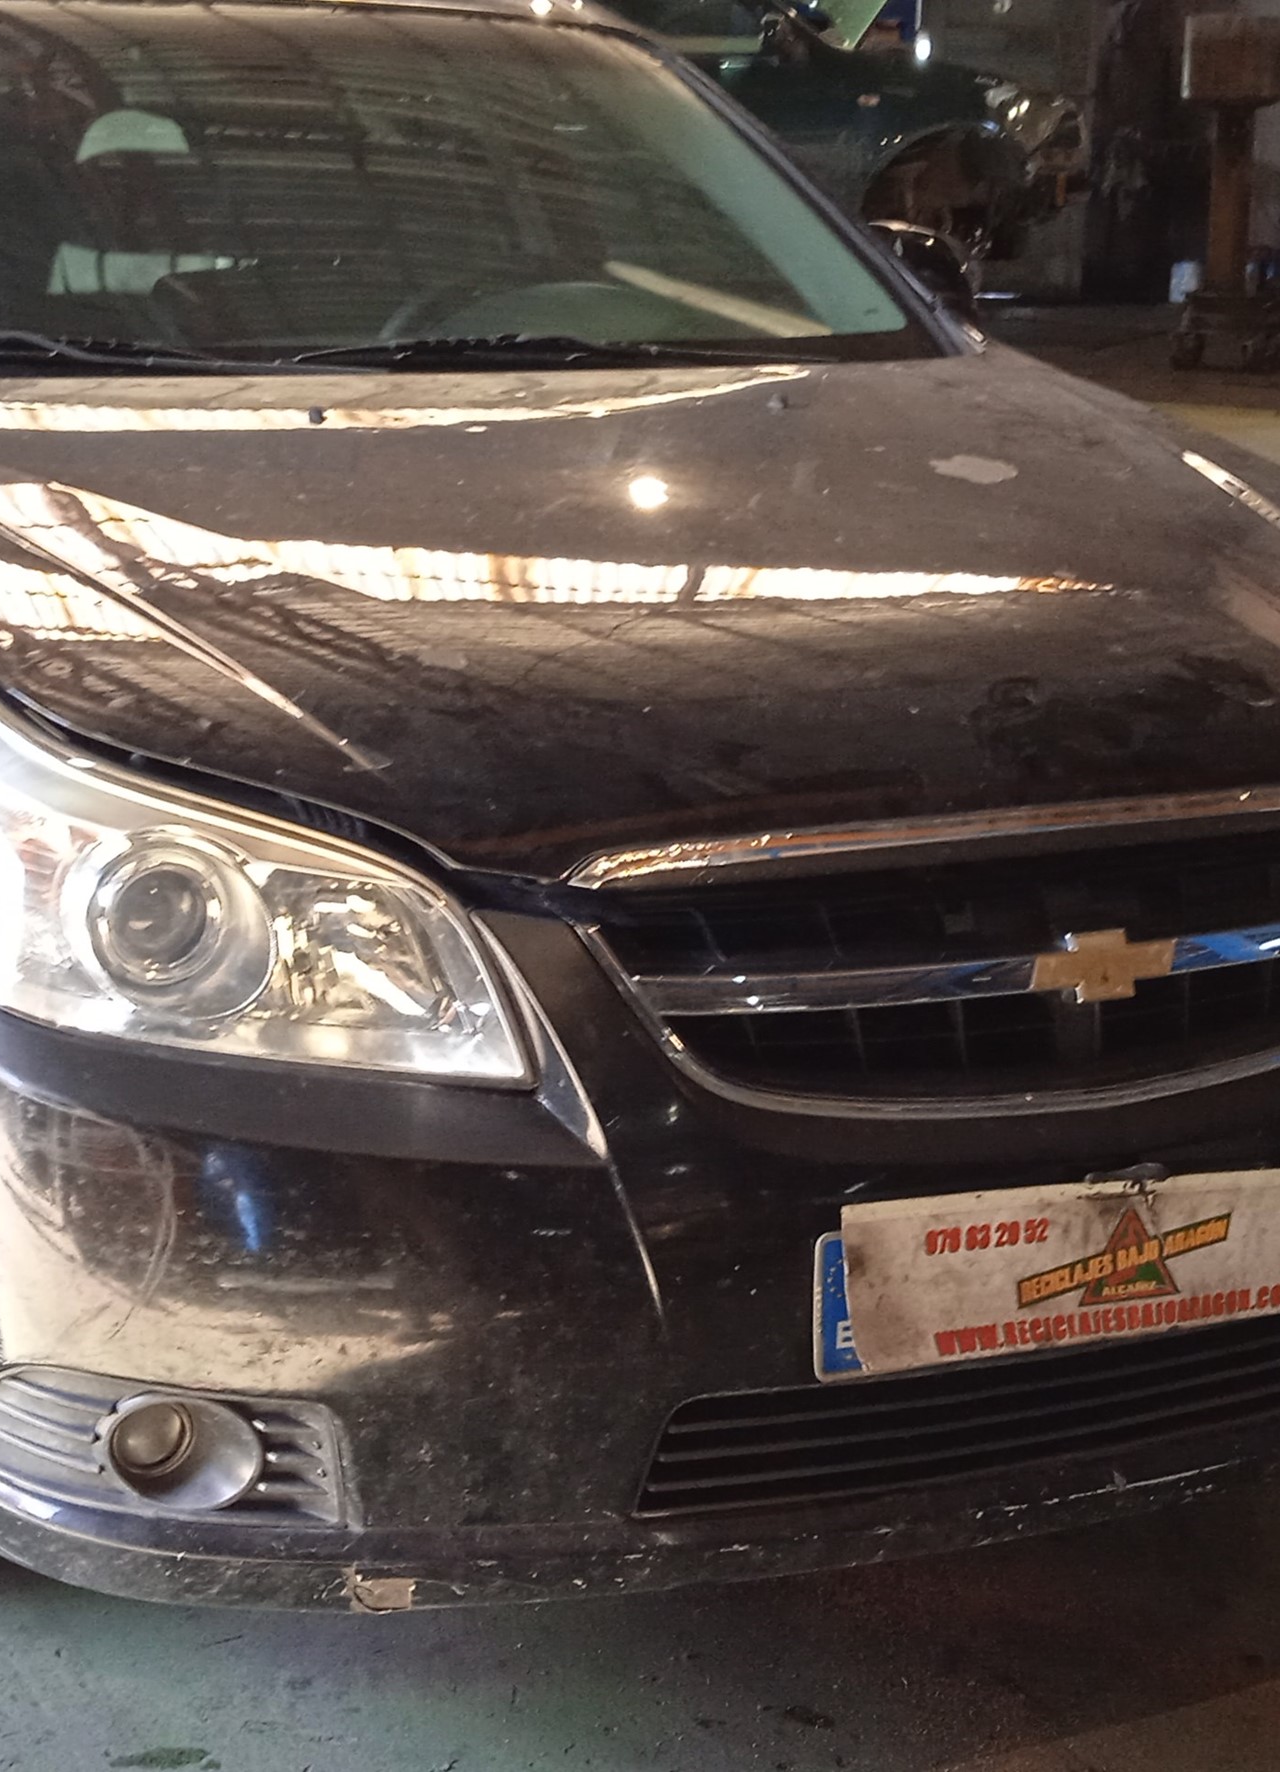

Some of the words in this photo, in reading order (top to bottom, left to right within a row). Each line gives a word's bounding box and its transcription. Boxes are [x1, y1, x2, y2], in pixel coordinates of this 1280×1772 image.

[994, 1220, 1020, 1248] 20
[1024, 1216, 1050, 1244] 52
[1021, 1252, 1114, 1301] RECICLAJES
[1117, 1238, 1160, 1269] BAJO
